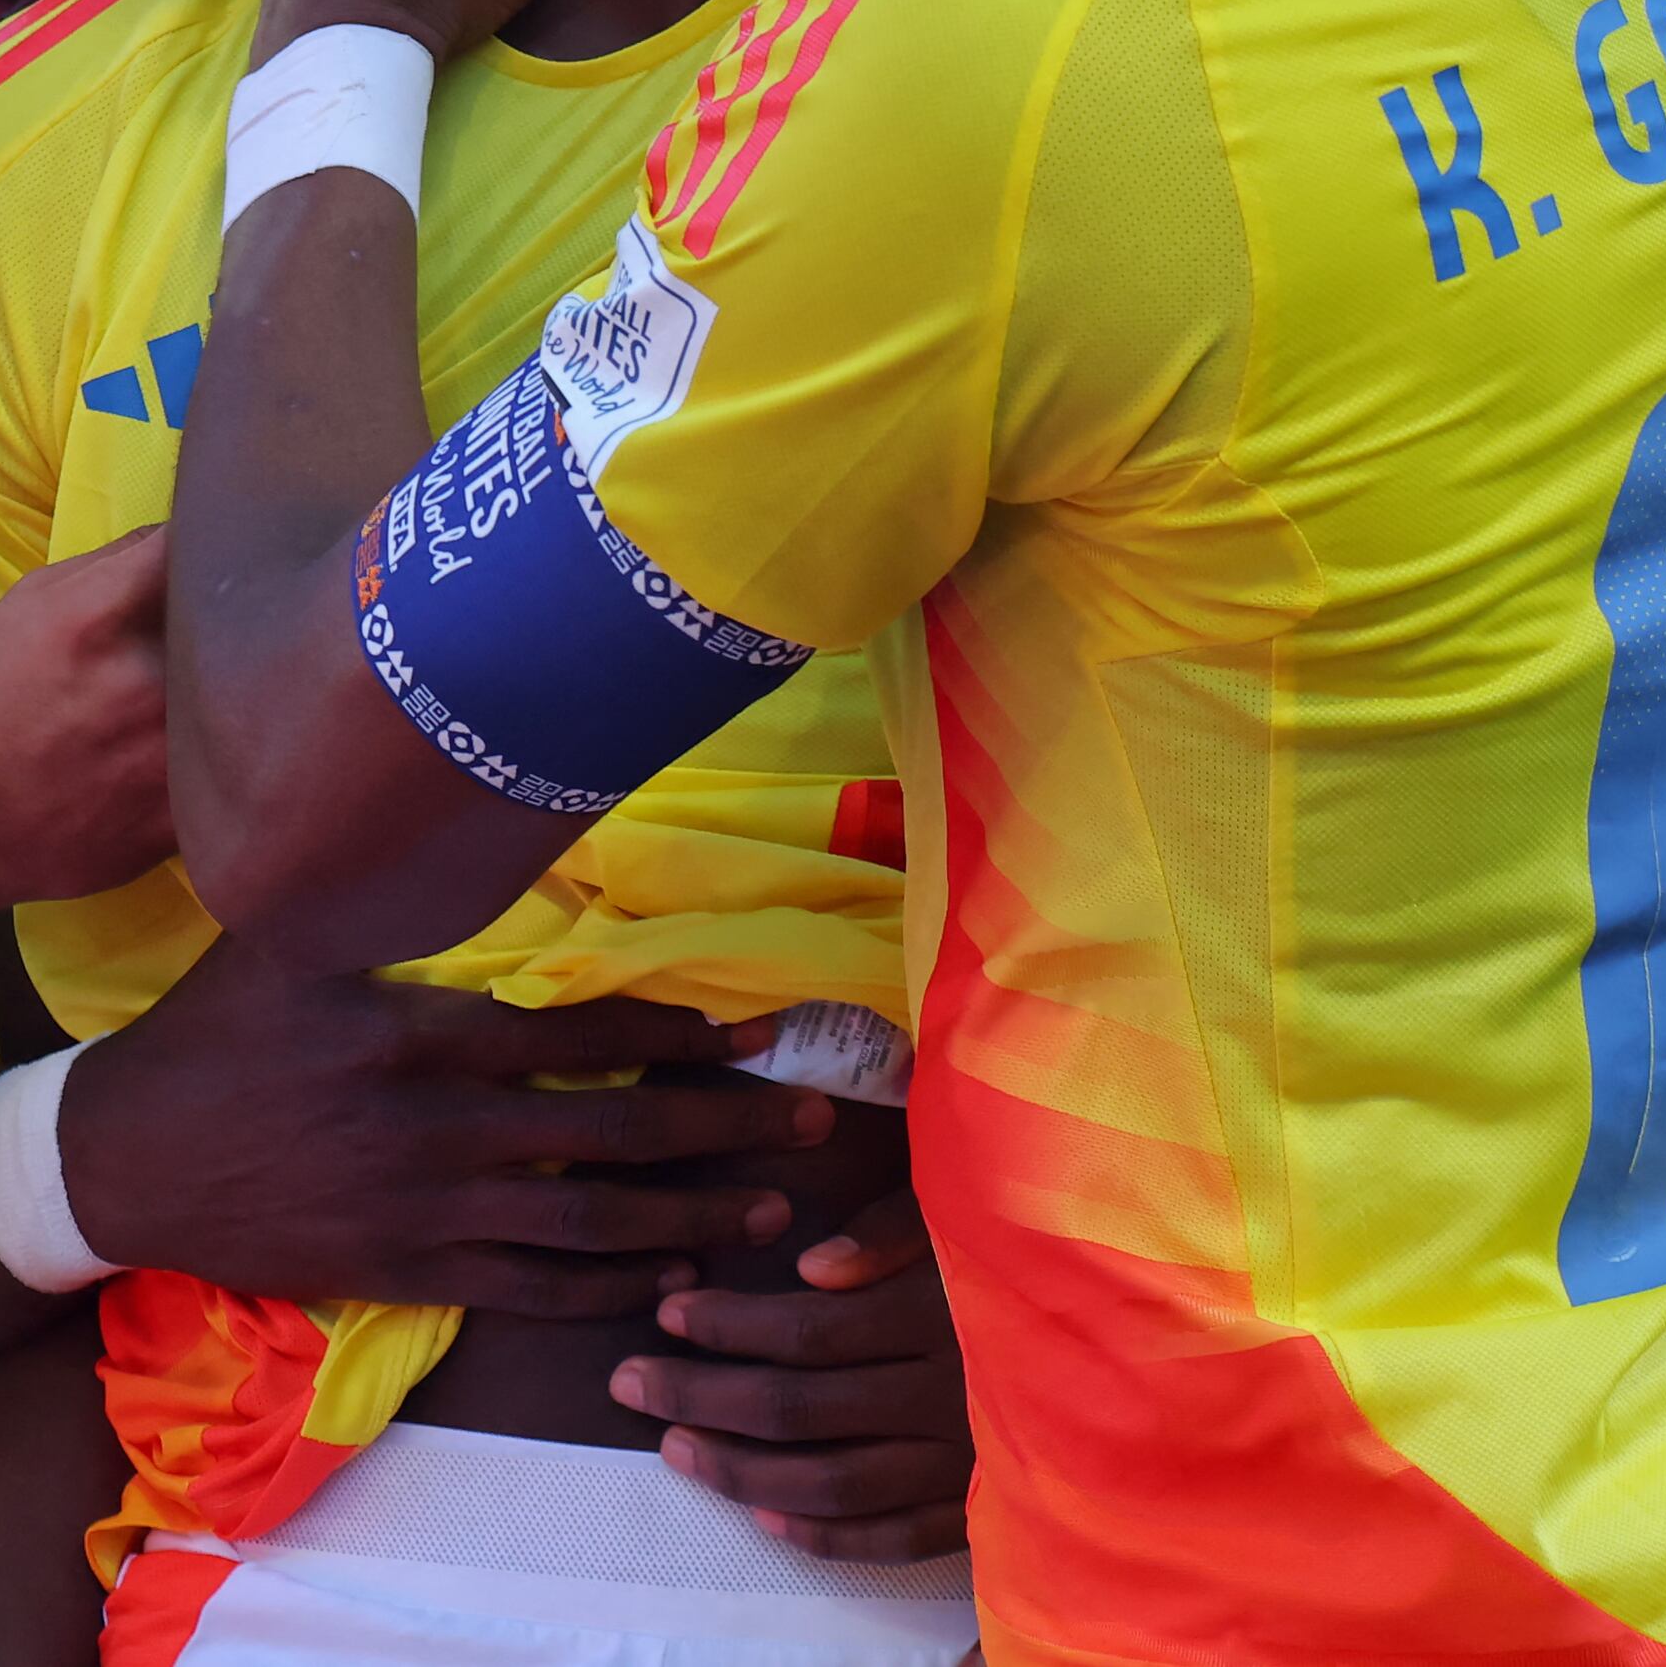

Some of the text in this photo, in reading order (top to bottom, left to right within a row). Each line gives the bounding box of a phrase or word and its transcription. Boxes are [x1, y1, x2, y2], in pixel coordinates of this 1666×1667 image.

[1378, 64, 1563, 284] K.
[462, 366, 526, 538] UNITES
[512, 357, 553, 505] OOTBALL
